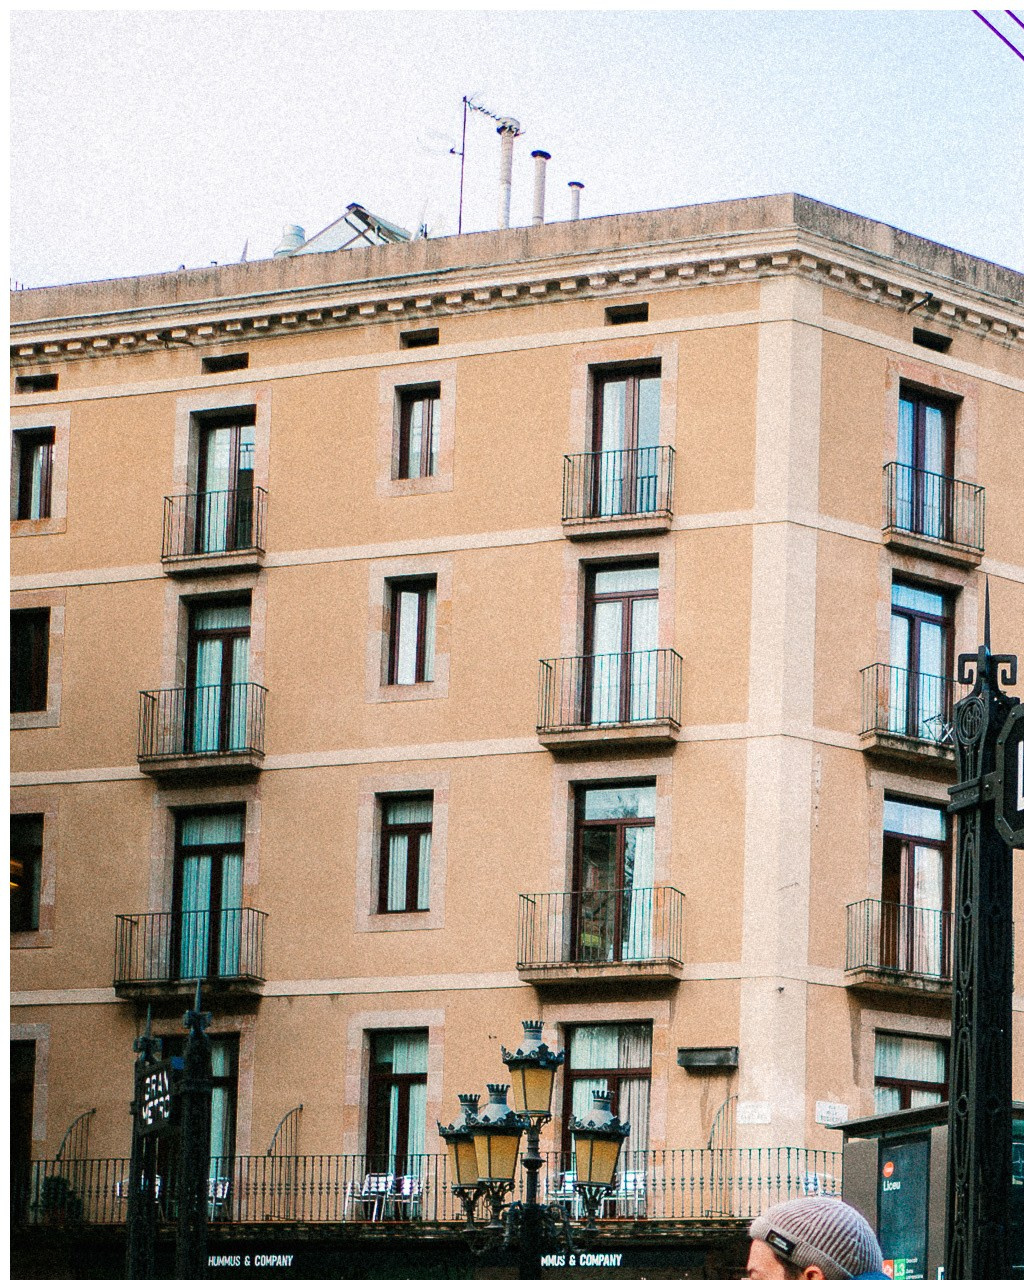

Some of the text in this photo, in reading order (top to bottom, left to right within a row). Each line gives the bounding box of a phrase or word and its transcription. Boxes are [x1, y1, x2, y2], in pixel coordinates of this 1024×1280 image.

[883, 1180, 901, 1191] Liceu
[207, 1254, 294, 1267] HUMMUS & COMPANY
[540, 1253, 623, 1267] MMUS & COMPANY
[894, 1262, 906, 1277] L3
